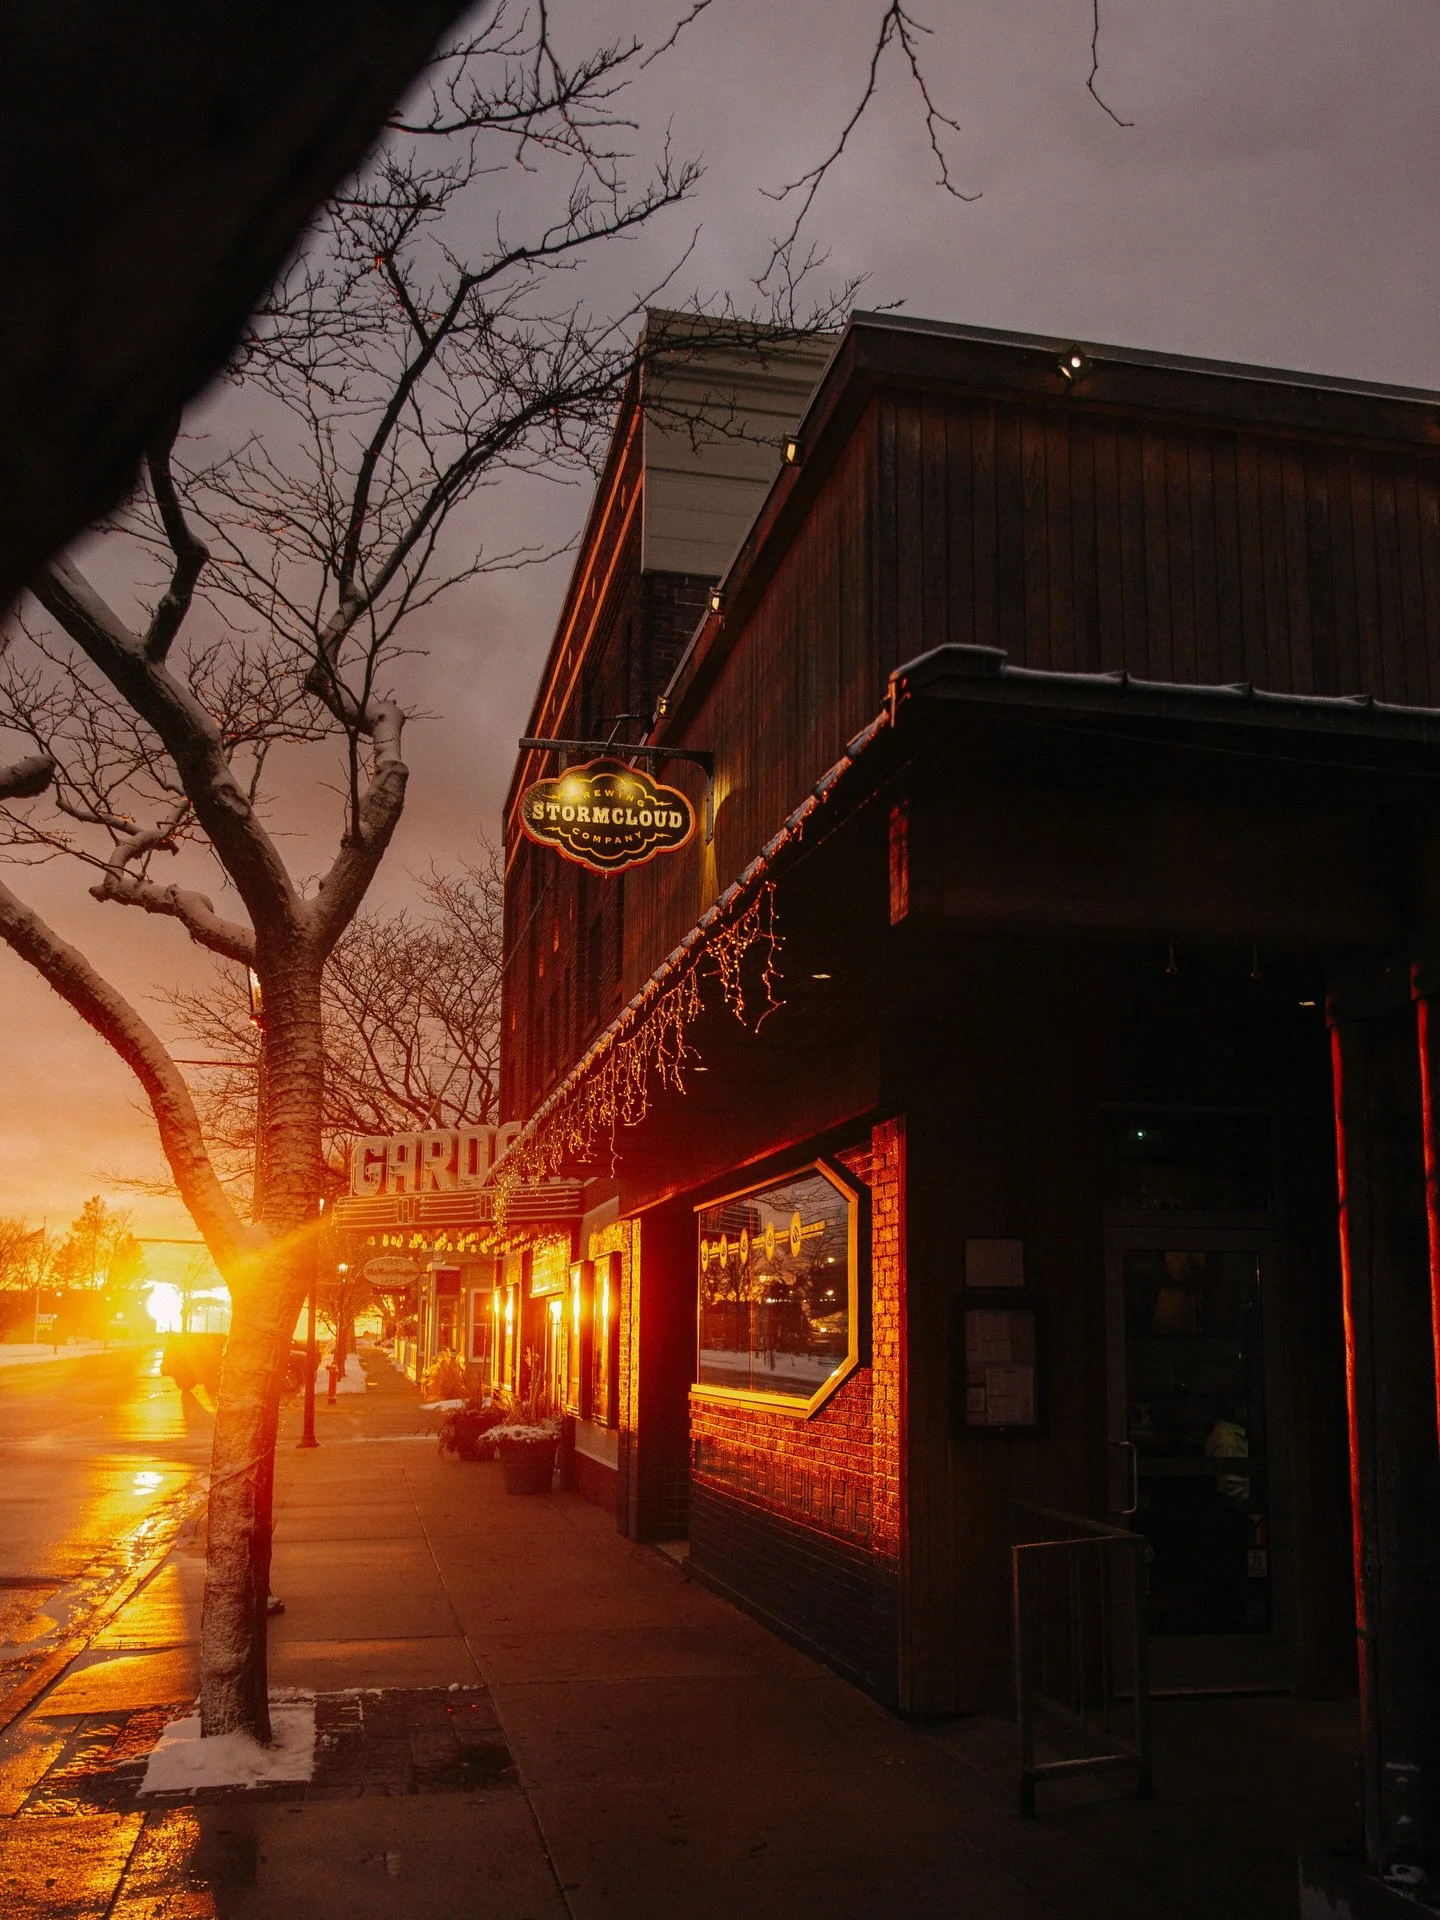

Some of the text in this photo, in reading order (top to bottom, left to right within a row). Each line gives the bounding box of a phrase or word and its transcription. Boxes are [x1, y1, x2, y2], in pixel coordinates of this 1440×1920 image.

[570, 789, 644, 807] REWING
[532, 803, 682, 828] STORMCLOUD
[572, 828, 642, 844] COMPANY
[353, 1121, 548, 1196] GARD
